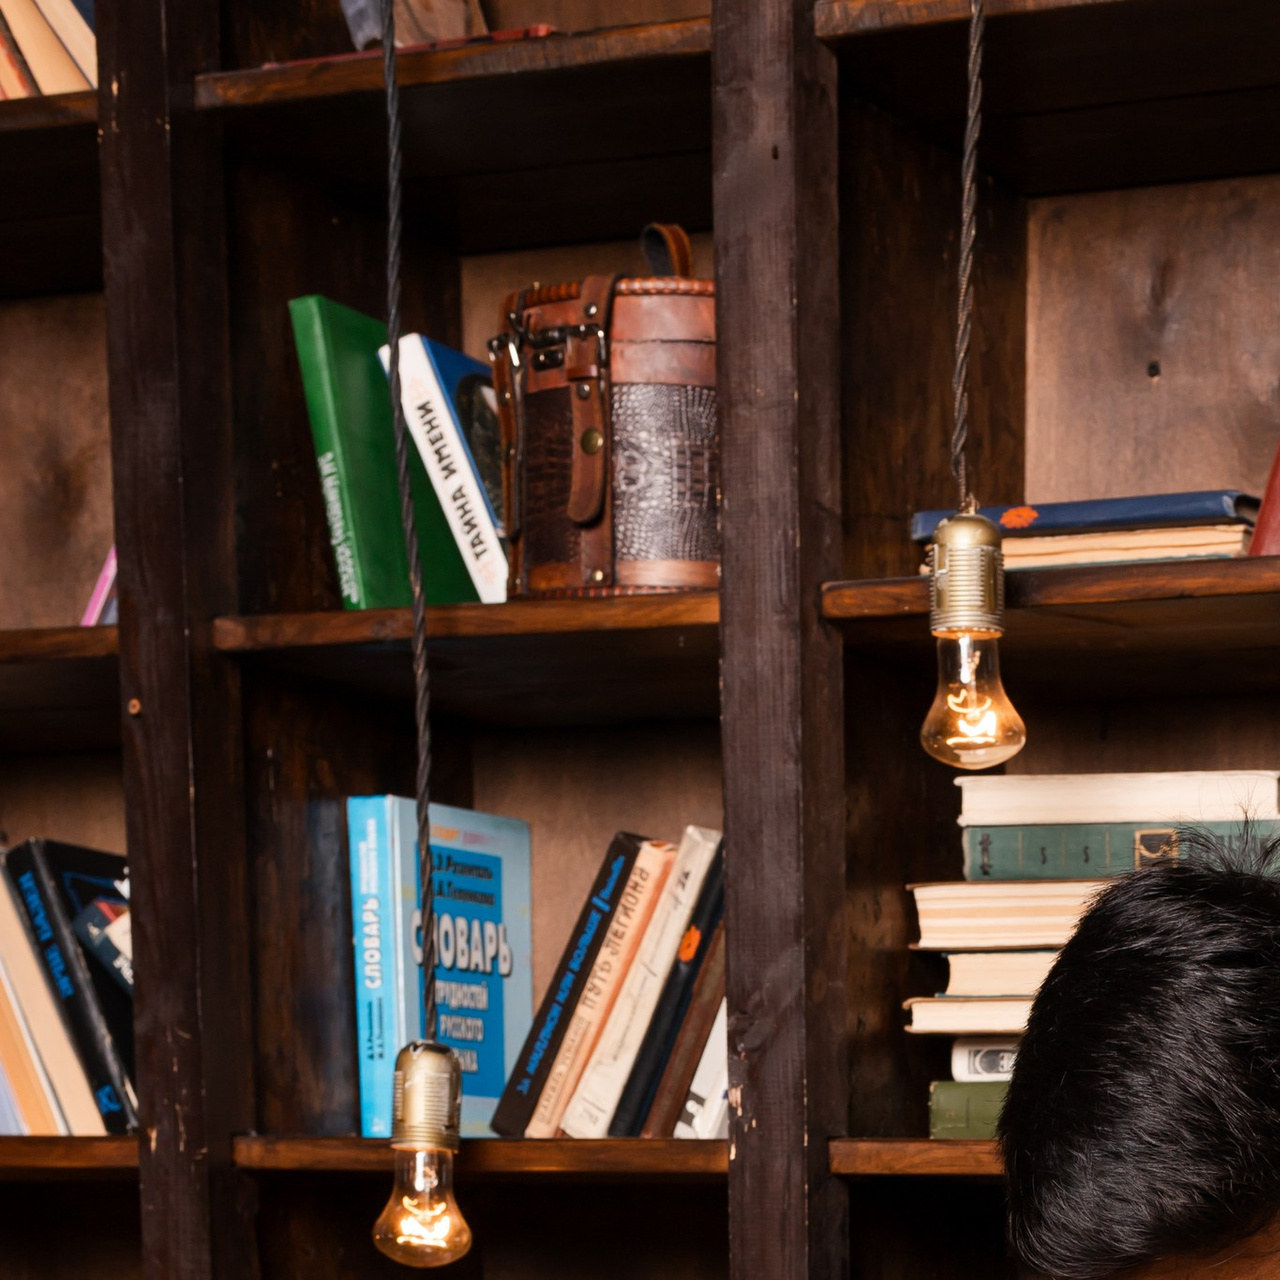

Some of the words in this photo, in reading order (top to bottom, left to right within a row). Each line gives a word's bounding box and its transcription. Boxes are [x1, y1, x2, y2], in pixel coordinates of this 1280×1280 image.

[416, 400, 457, 480] ИМЕНИ
[451, 485, 488, 561] ТАЙНА
[362, 895, 383, 990] СЛОВАРЬ
[581, 959, 612, 1016] ПУТЬ
